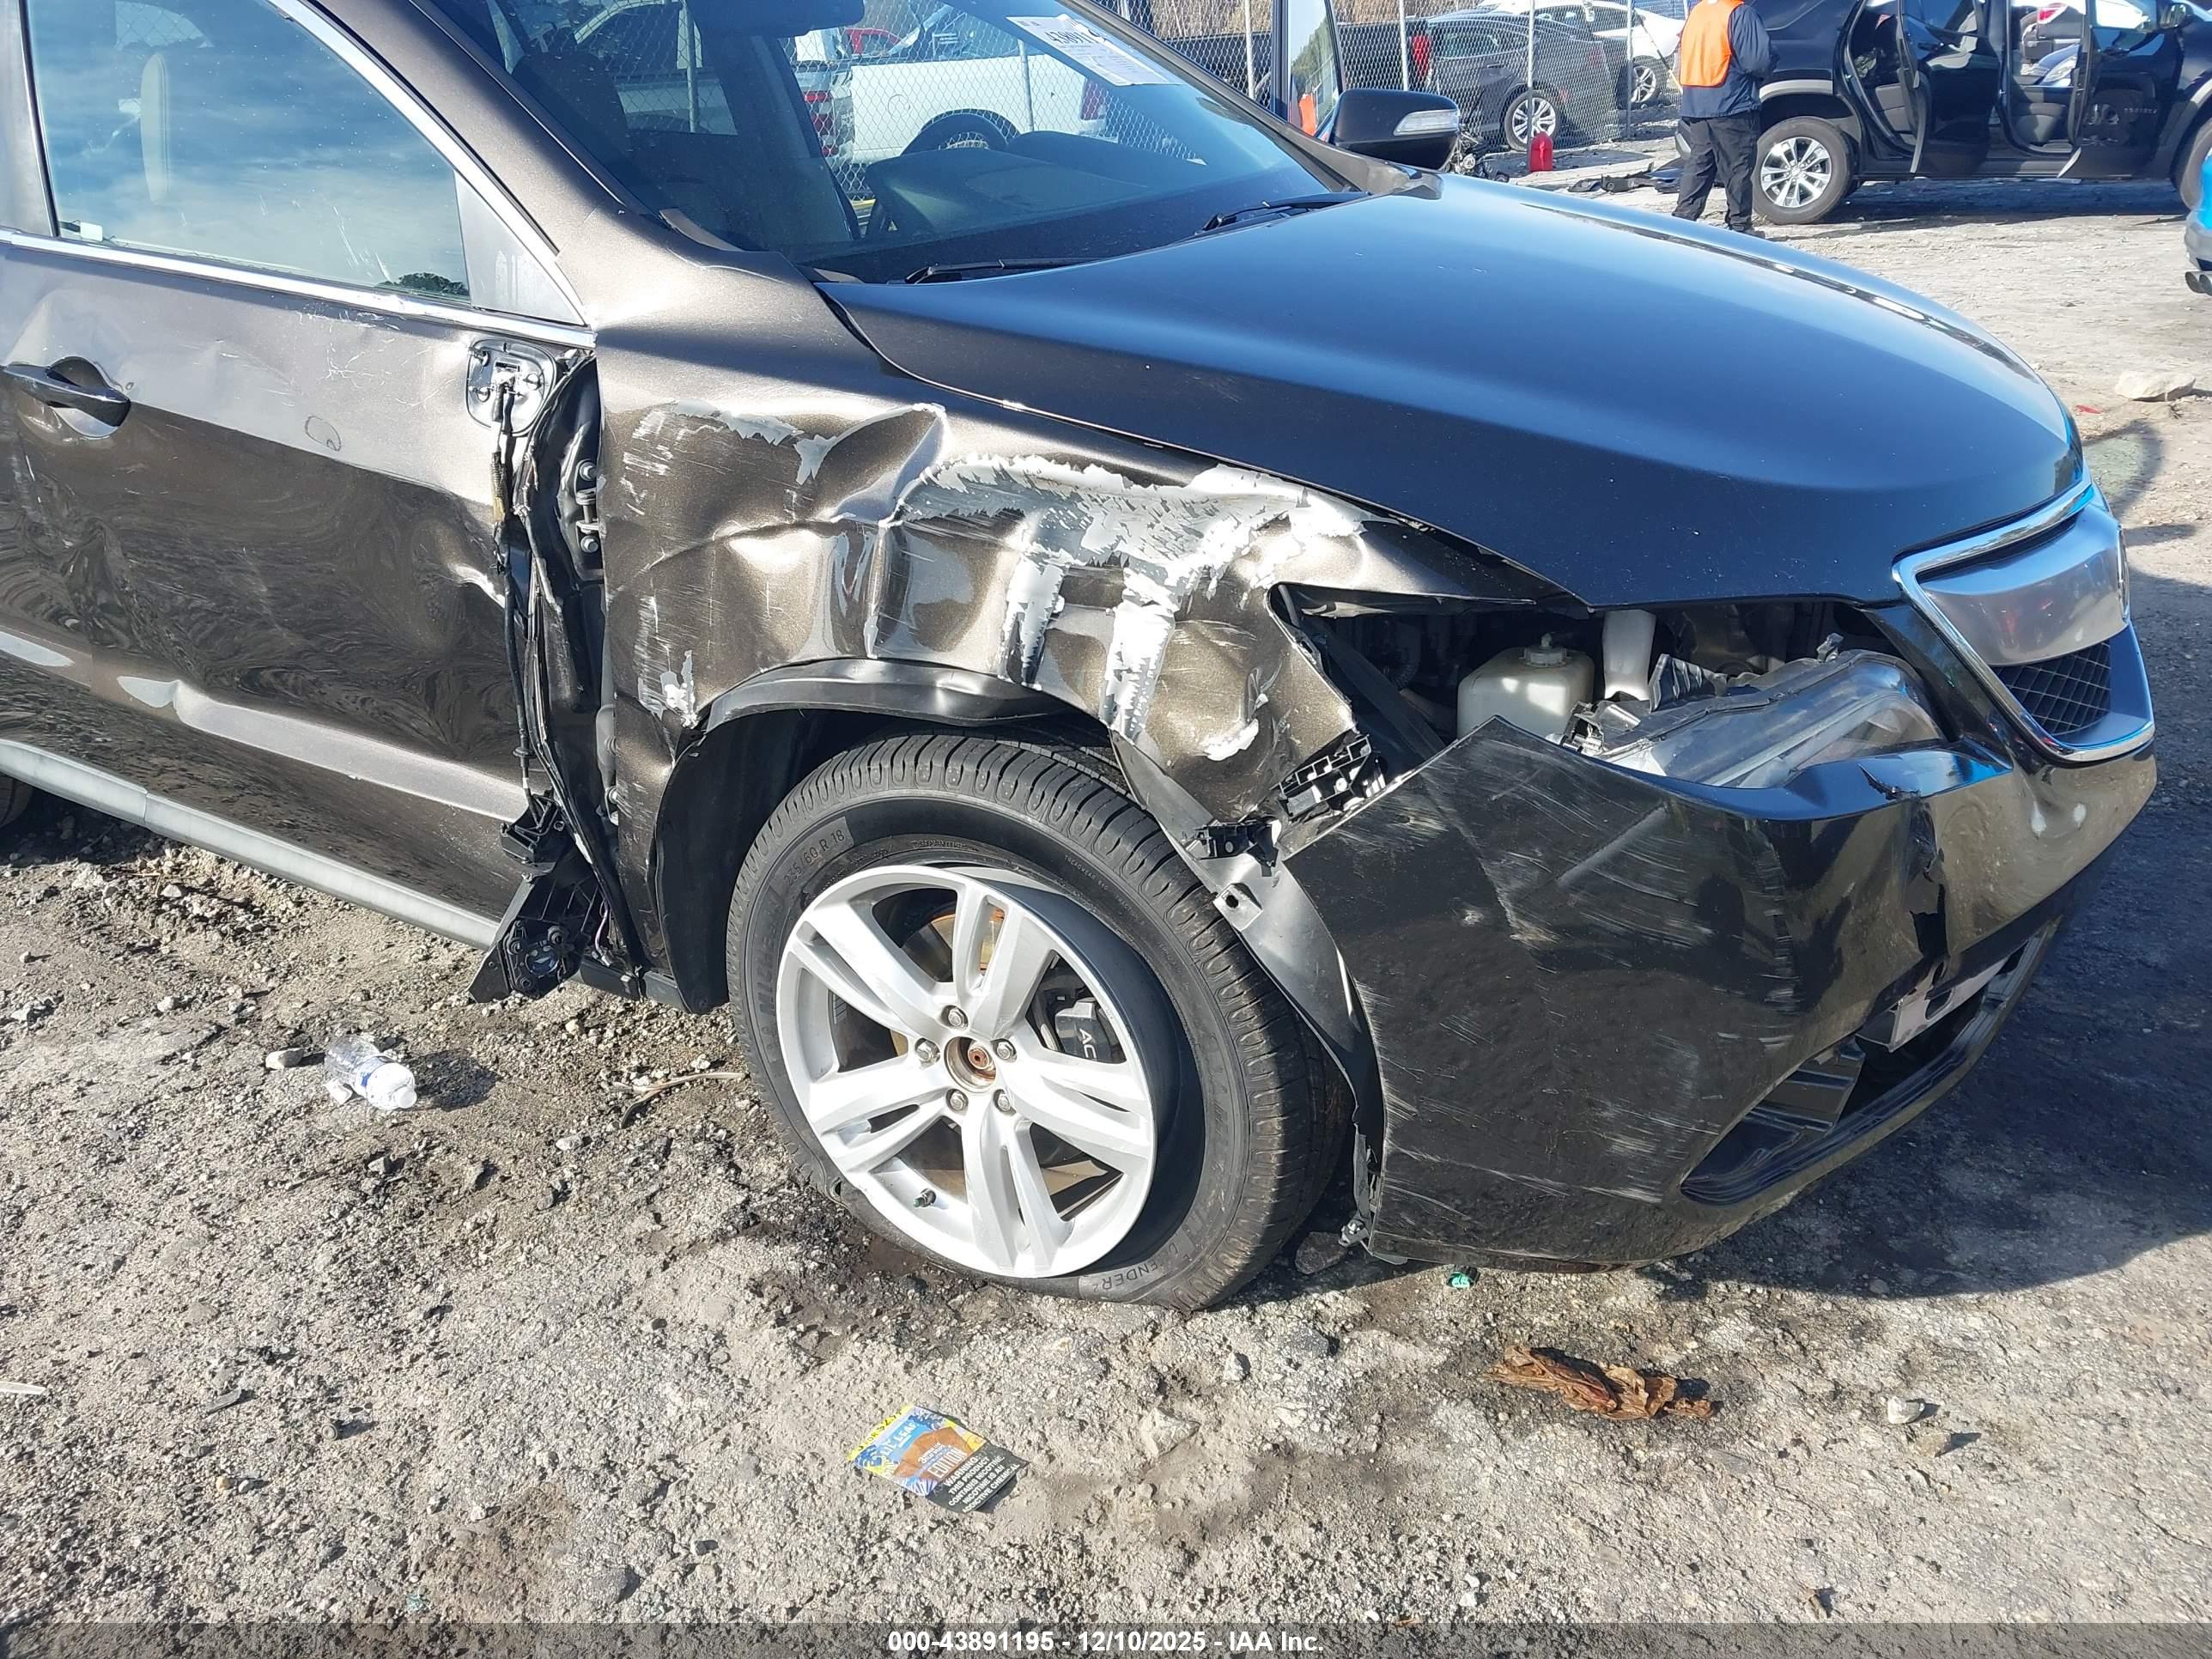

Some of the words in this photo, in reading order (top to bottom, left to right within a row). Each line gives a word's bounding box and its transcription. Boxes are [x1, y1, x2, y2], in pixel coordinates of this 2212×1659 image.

[819, 839, 830, 851] R
[830, 830, 844, 844] 18
[1079, 1028, 1097, 1060] AC
[927, 1449, 969, 1479] EDITION
[943, 1455, 981, 1487] WARNING:
[948, 1480, 964, 1495] THIS
[963, 1456, 990, 1483] PRODUCT
[949, 1478, 979, 1506] CONTAINS
[975, 1455, 1005, 1480] NICOTINE.
[962, 1479, 990, 1504] NICOTINE
[989, 1473, 997, 1482] IS
[996, 1464, 1005, 1475] AN
[963, 1487, 993, 1513] ADDICTIVE
[990, 1463, 1020, 1489] CHEMICAL
